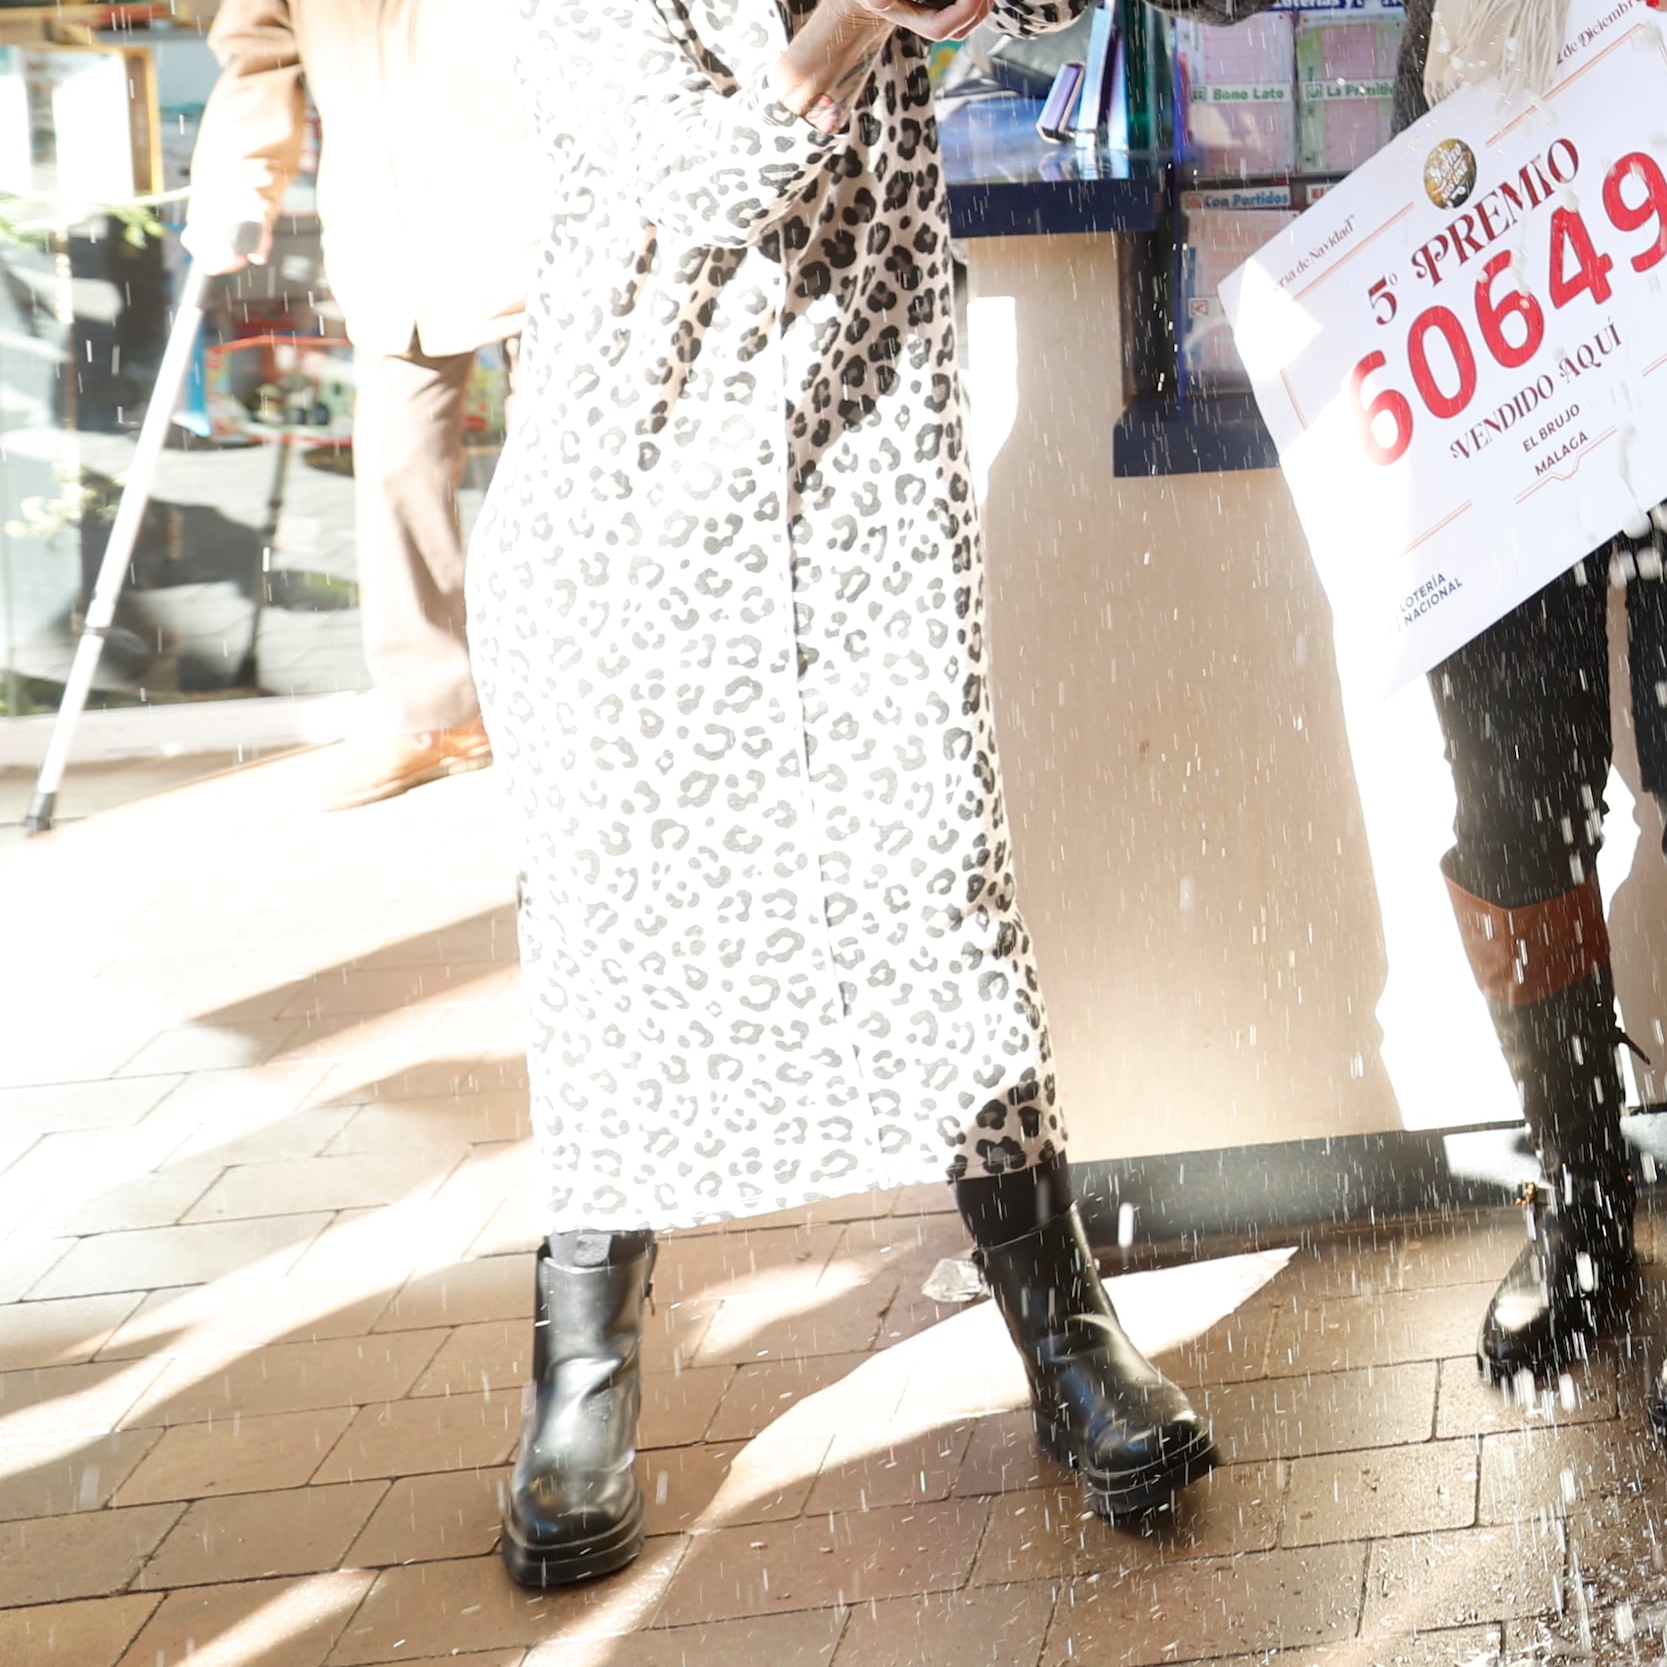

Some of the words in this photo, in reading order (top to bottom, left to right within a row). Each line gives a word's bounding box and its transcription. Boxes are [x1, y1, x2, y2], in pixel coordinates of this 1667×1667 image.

[1213, 88, 1248, 100] Bono
[1253, 88, 1284, 100] Loto
[1327, 85, 1341, 97] La
[1204, 193, 1229, 207] Con
[1233, 191, 1288, 206] Partidos
[1411, 138, 1579, 286] PREMIO
[1309, 214, 1357, 267] Navidad
[1450, 374, 1555, 460] VENDIDO
[1559, 316, 1623, 383] AQUÍ
[1522, 433, 1540, 452] EL
[1539, 403, 1581, 440] BRUJO
[1534, 430, 1589, 476] MALAGA
[1400, 572, 1447, 614] LOTERÍA
[1404, 576, 1464, 626] NACIONAL
